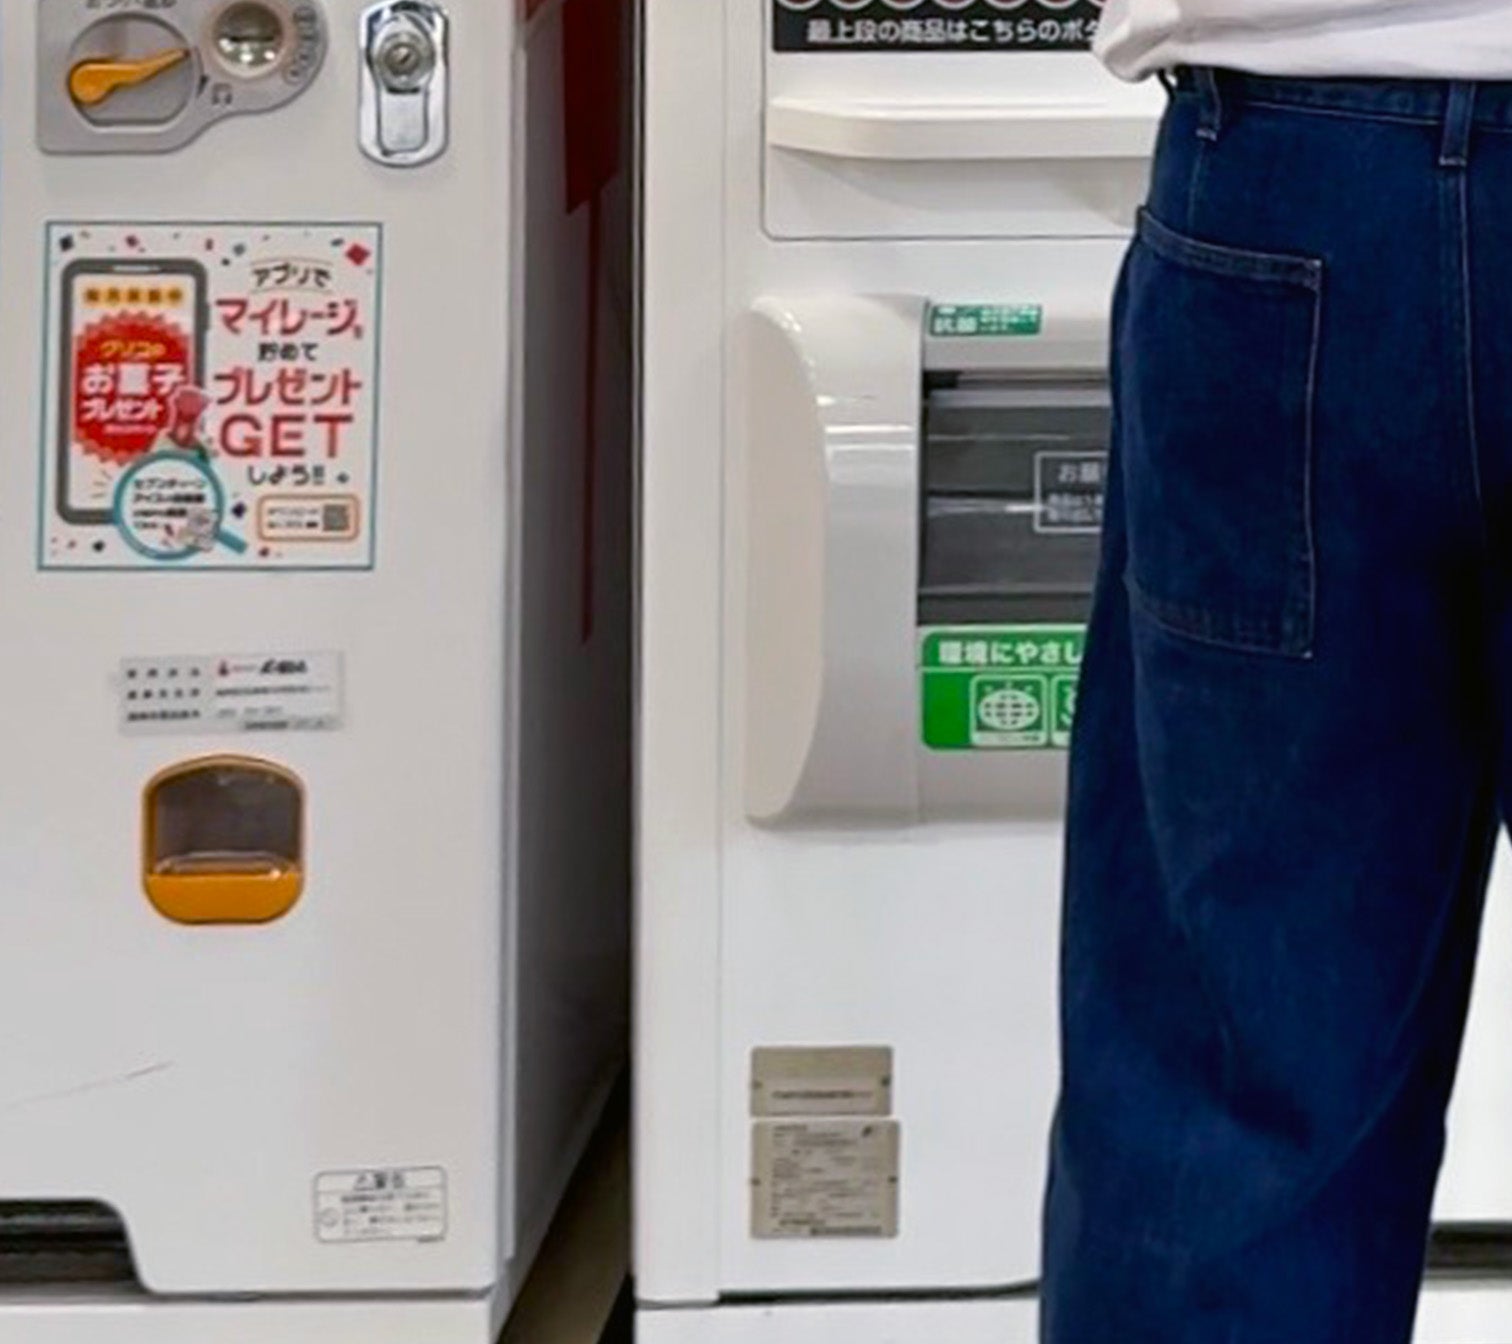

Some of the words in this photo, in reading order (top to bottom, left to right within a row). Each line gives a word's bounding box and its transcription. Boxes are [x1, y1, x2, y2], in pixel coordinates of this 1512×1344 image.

[253, 263, 332, 288] アプリで
[258, 342, 319, 361] 貯めて
[213, 367, 362, 406] プレゼント
[218, 413, 354, 459] GET
